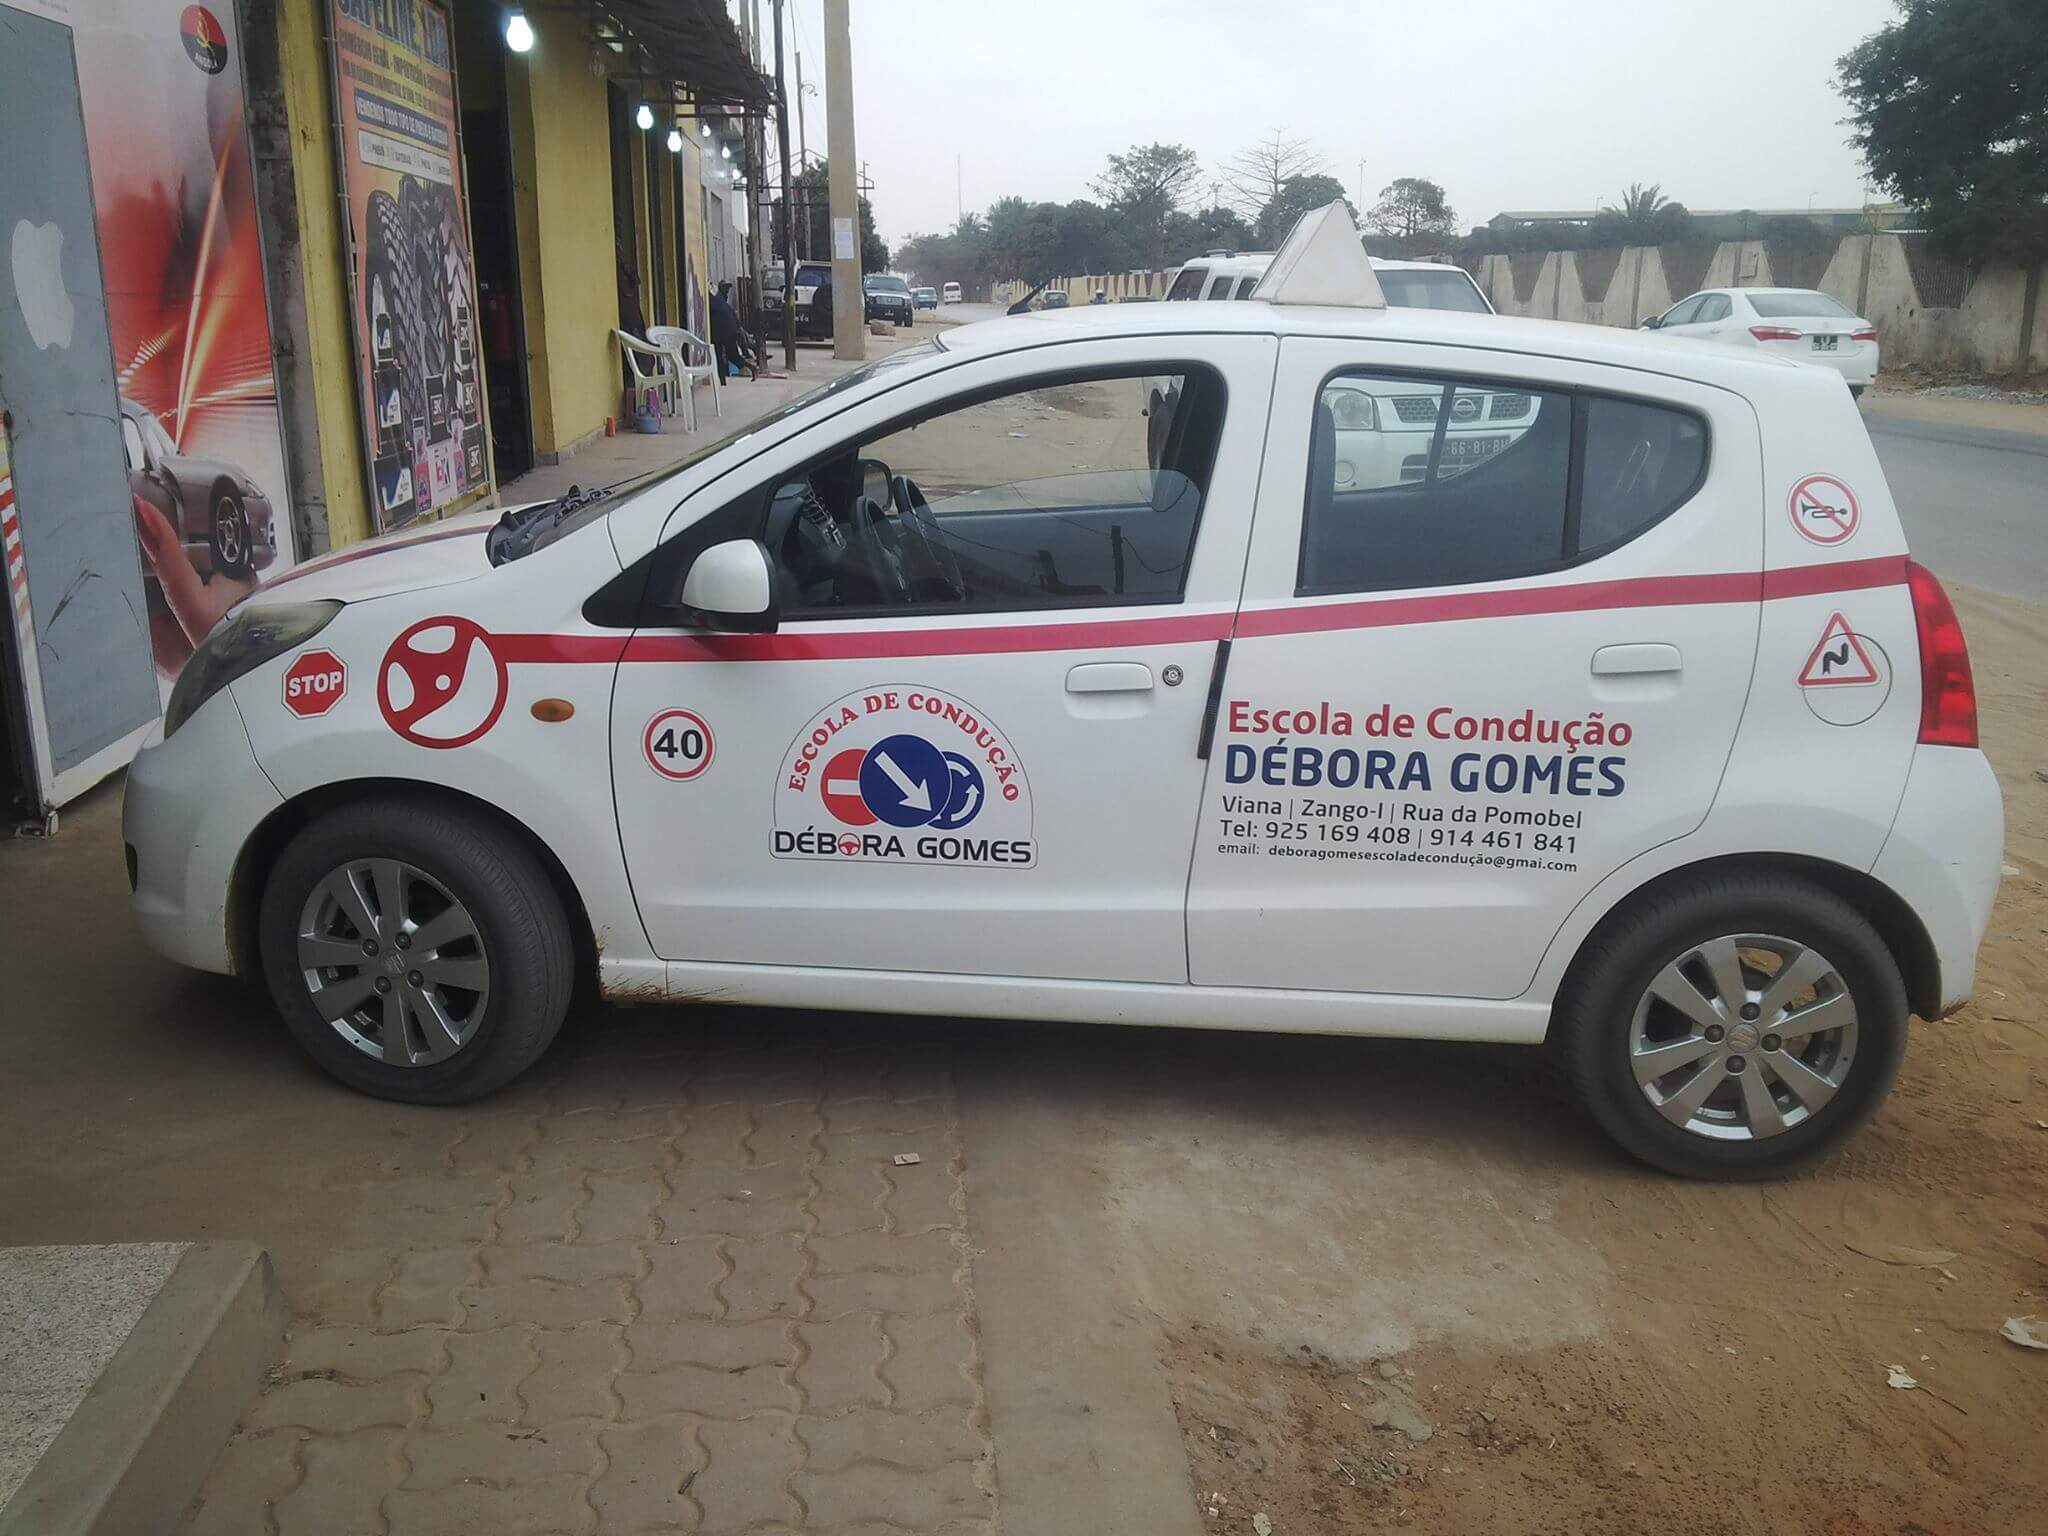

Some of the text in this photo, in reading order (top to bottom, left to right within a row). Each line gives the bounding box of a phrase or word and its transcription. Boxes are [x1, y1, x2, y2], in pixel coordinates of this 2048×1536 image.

[288, 670, 343, 697] STOP
[653, 728, 703, 760] 40
[1229, 701, 1633, 754] Escola de Condução
[788, 692, 1020, 801] ESCOLA DE CONDUÇÃO
[1225, 738, 1626, 797] DÉBORA GOMES
[1222, 795, 1283, 815] Viana
[1402, 803, 1444, 822] Rua
[1451, 805, 1477, 823] da
[1484, 806, 1582, 829] Pomobel
[916, 836, 1032, 863] GOMES
[1220, 819, 1258, 838] Tel:
[1265, 821, 1308, 840] 925
[1318, 824, 1359, 842] 169
[1366, 826, 1411, 845] 408
[1430, 828, 1474, 847] 914
[1481, 831, 1523, 849] 461
[1534, 834, 1576, 854] 841
[1217, 843, 1578, 872] email: deboragomesescoladecondução@gmai.com
